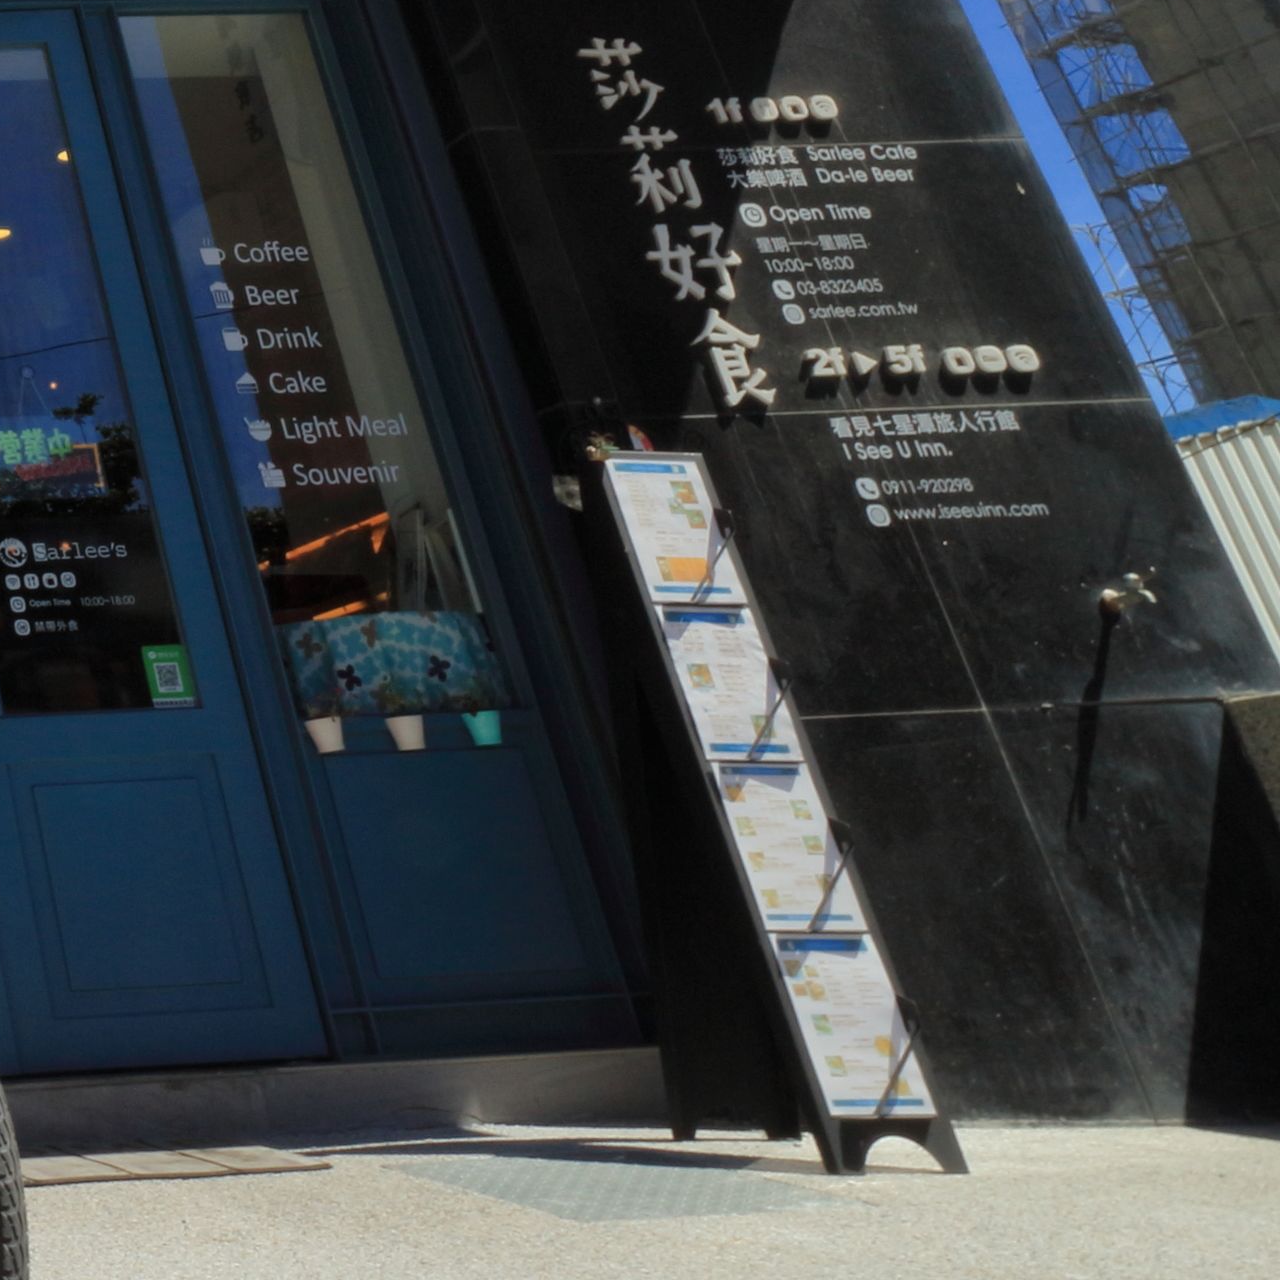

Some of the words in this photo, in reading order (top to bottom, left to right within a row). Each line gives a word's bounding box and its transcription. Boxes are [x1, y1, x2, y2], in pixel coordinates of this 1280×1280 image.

[806, 145, 866, 162] Sarlee
[870, 145, 918, 161] Cafe
[815, 168, 868, 184] Da-le
[871, 168, 915, 183] Beer
[769, 205, 824, 225] Open
[825, 204, 872, 220] Time
[234, 241, 310, 264] Coffee
[244, 285, 300, 306] Beer
[809, 302, 919, 320] sarlee.com.tw
[256, 326, 323, 349] Drink
[268, 371, 328, 394] Cake
[281, 416, 342, 444] Light
[345, 413, 408, 437] Meal
[855, 441, 893, 460] See
[896, 440, 911, 459] U
[915, 439, 953, 458] Inn.
[293, 460, 400, 488] Souvenir
[894, 501, 1050, 520] www.iseeuinn.com
[32, 542, 128, 561] Sarlee's
